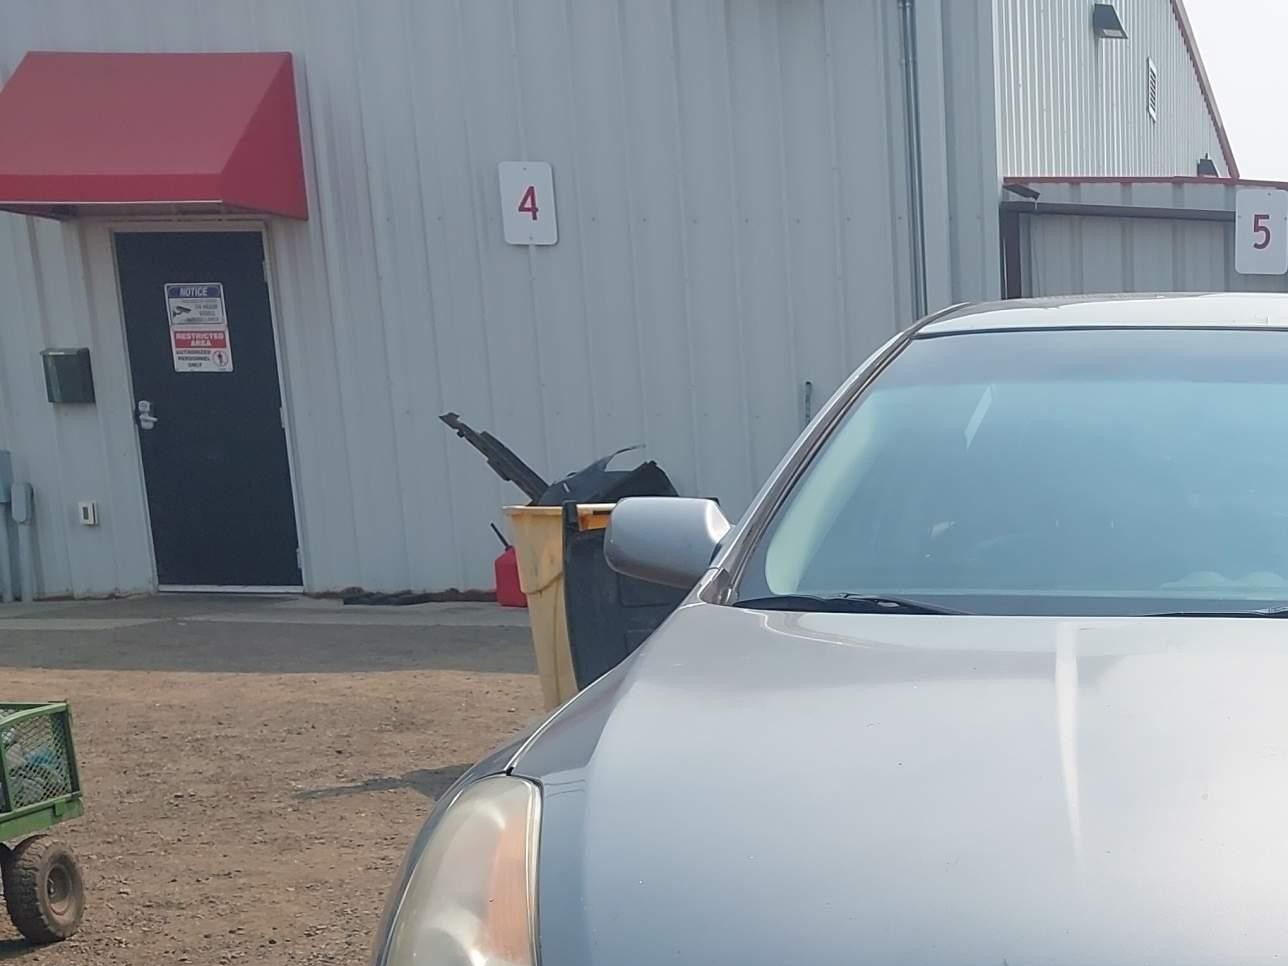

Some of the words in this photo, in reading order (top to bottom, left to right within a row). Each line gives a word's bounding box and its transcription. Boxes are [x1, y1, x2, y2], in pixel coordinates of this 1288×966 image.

[518, 186, 539, 220] 4
[1253, 214, 1271, 250] 5
[179, 287, 208, 296] NOTICE
